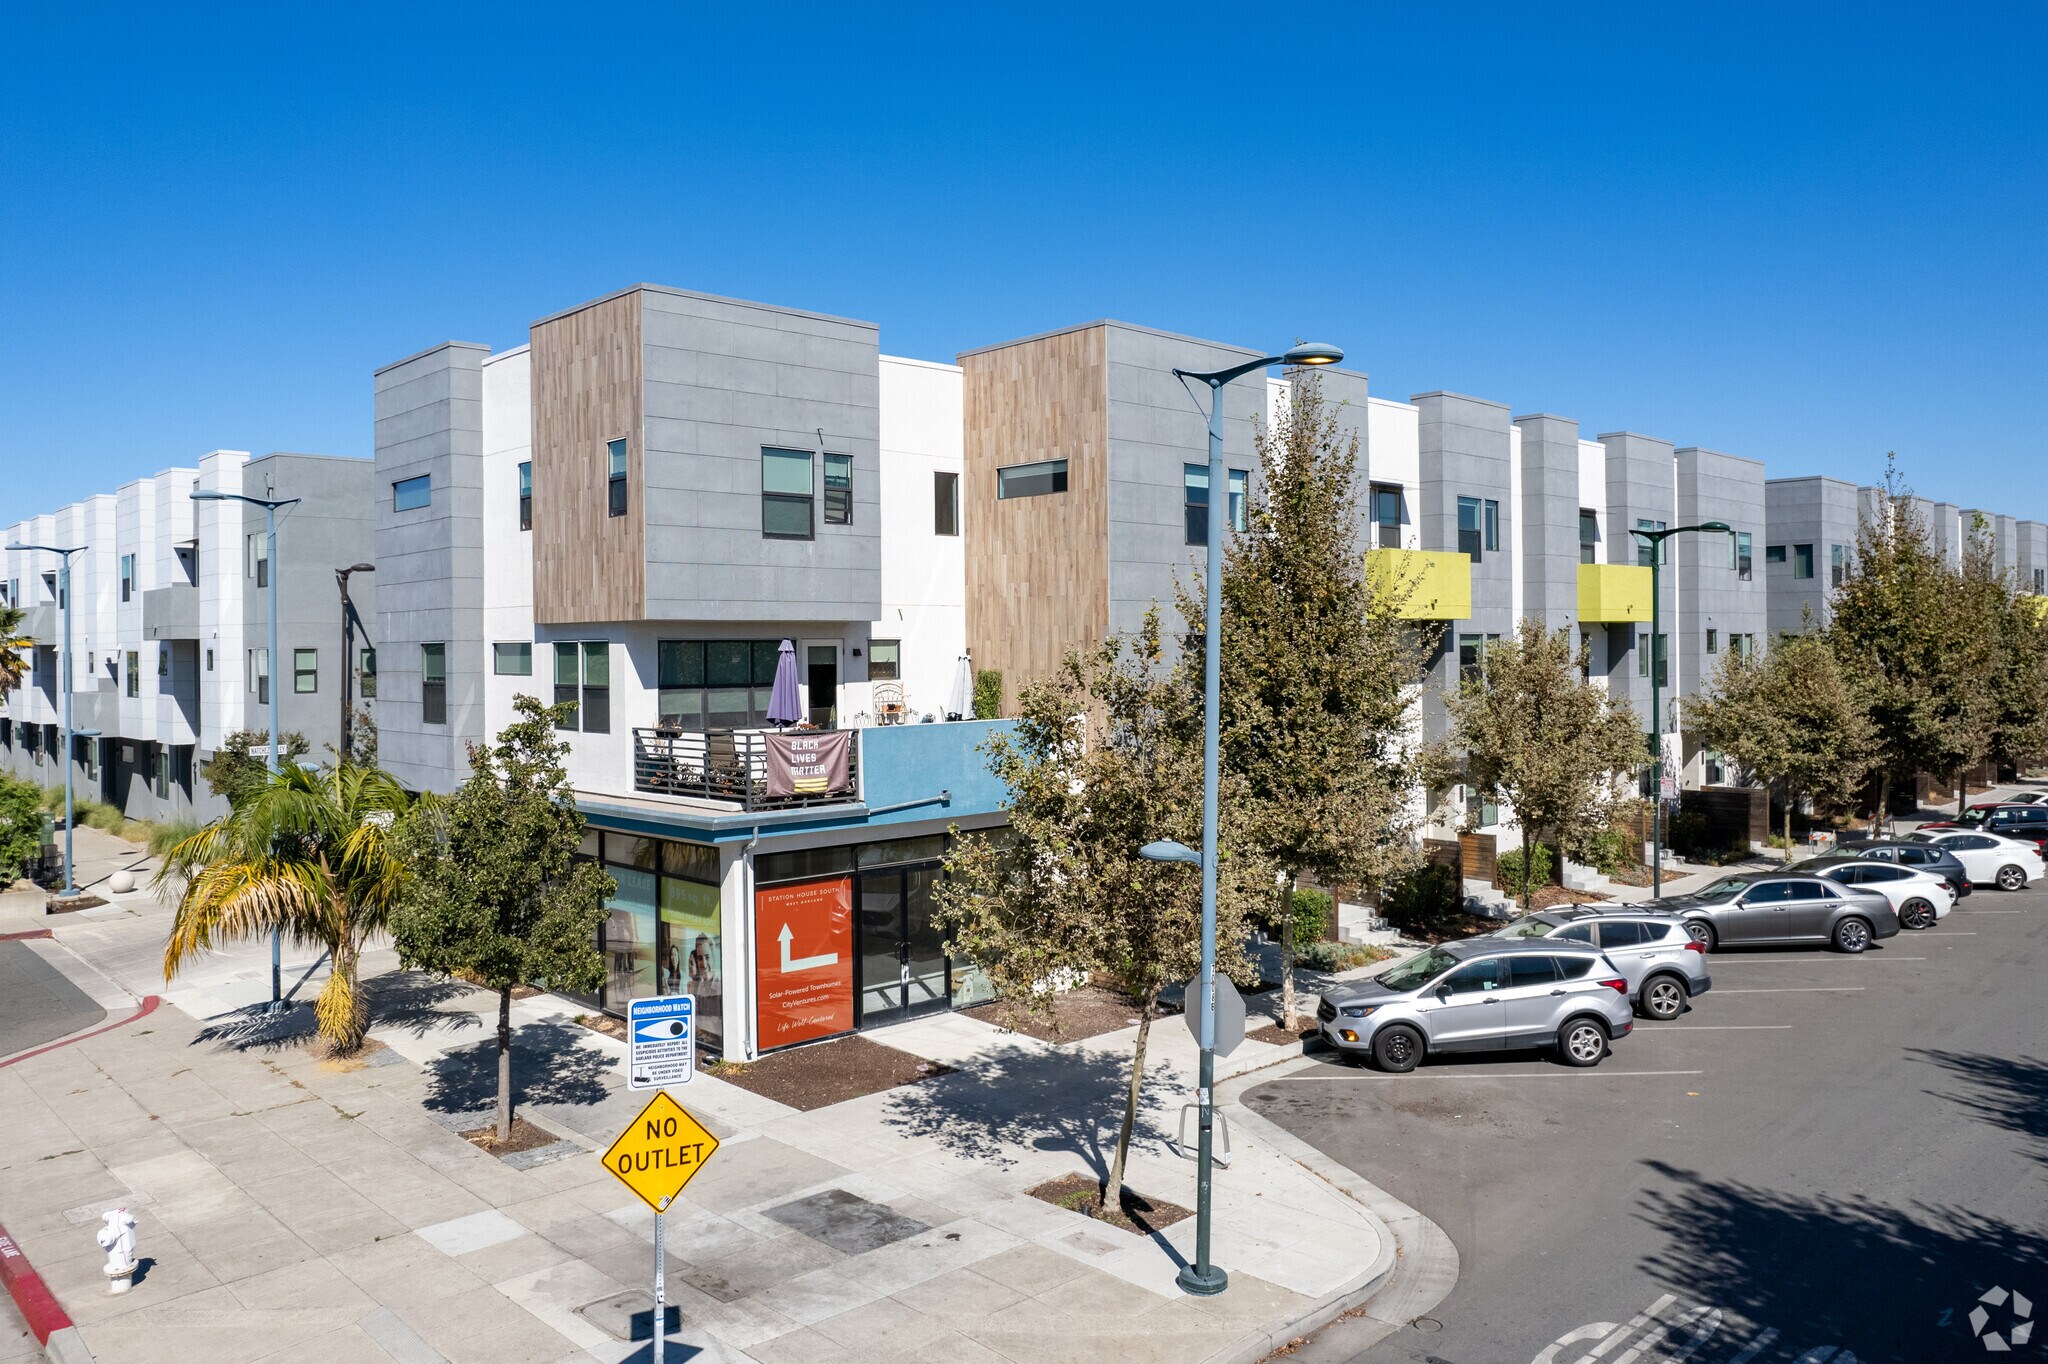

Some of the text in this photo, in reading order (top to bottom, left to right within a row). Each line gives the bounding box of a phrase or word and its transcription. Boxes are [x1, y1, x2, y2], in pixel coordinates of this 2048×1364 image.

[791, 740, 819, 750] BLACK
[791, 753, 817, 763] LIVES
[791, 764, 826, 775] MATTER
[768, 893, 794, 902] STATION
[819, 887, 840, 895] SOUTH
[769, 980, 842, 999] Solar-Powered Townhomes
[633, 1003, 690, 1015] NEIGHBORHOOD WATCH
[782, 994, 829, 1009] CityVentures.com
[777, 1012, 835, 1033] Life Well-Centered
[646, 1117, 677, 1140] NO
[618, 1143, 704, 1174] OUTLET
